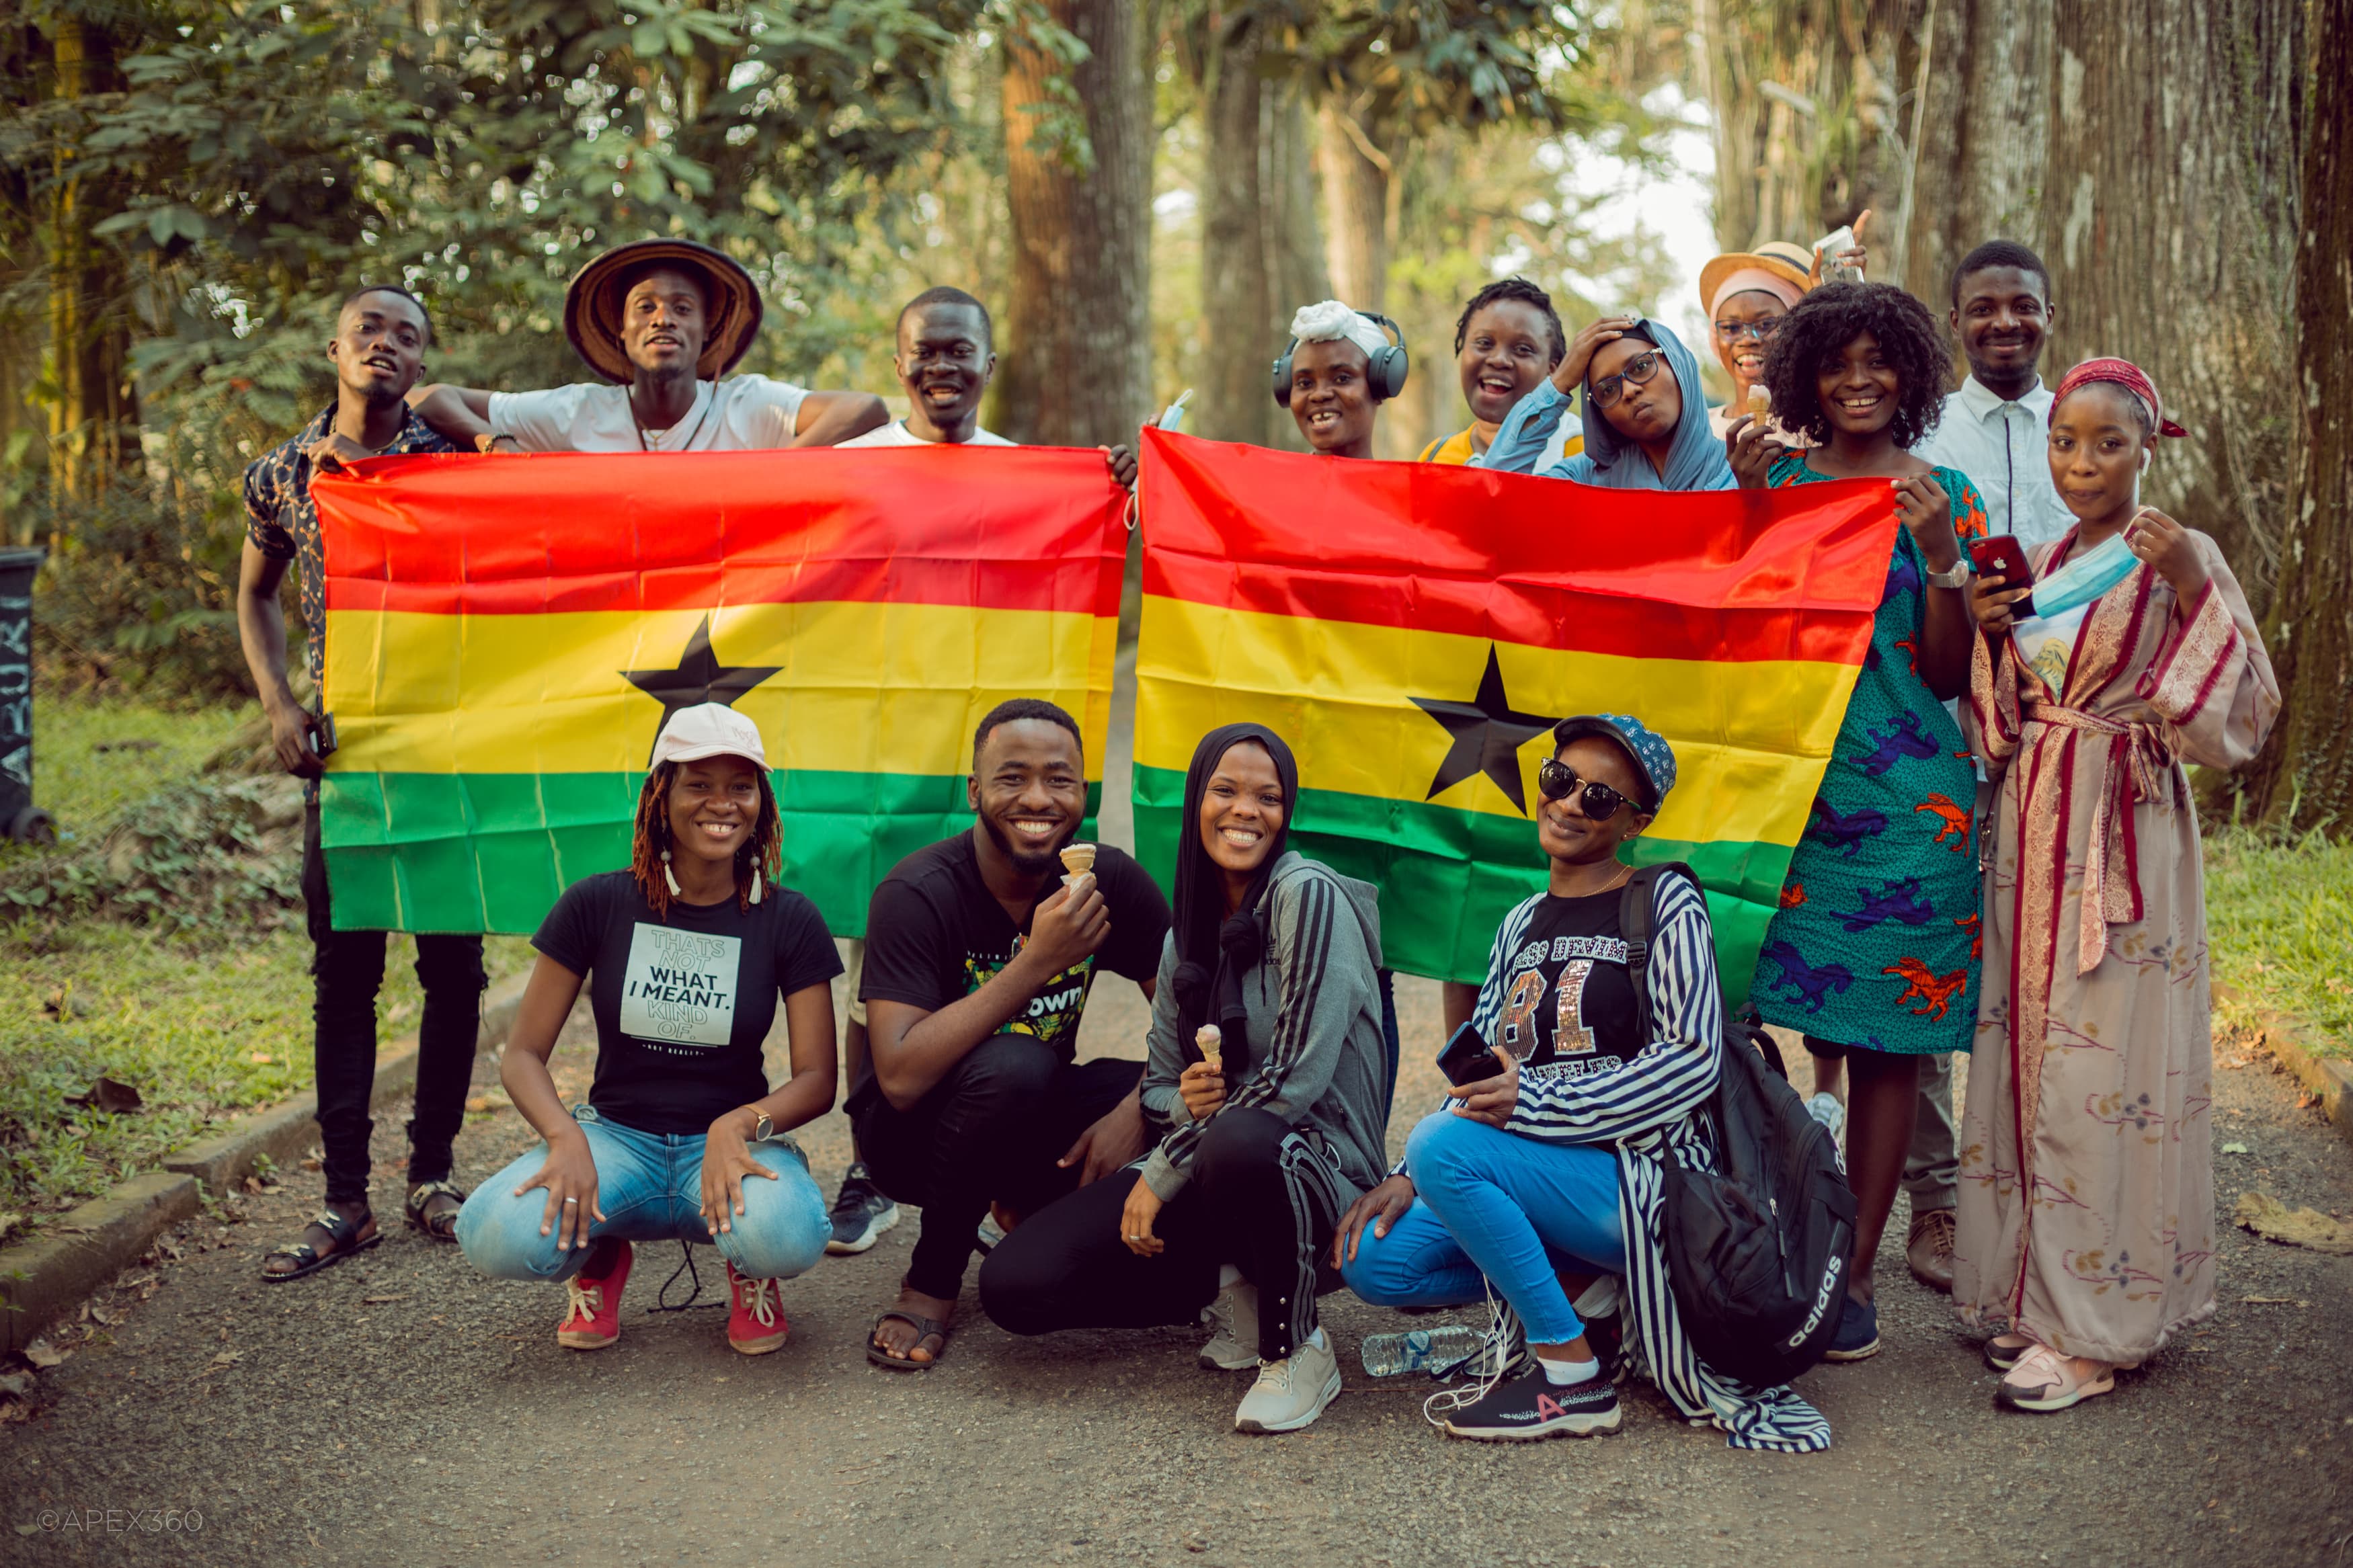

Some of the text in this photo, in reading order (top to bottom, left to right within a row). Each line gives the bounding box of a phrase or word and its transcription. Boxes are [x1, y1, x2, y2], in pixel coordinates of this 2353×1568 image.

[651, 930, 725, 958] THATS
[1551, 935, 1628, 964] DENIM
[659, 950, 711, 973] NOT
[650, 966, 717, 990] WHAT
[629, 981, 730, 1010] I MEANT.
[648, 1000, 708, 1025] KIND
[1497, 960, 1596, 1063] 81
[657, 1021, 696, 1040] OF.
[1789, 1255, 1841, 1347] adidas
